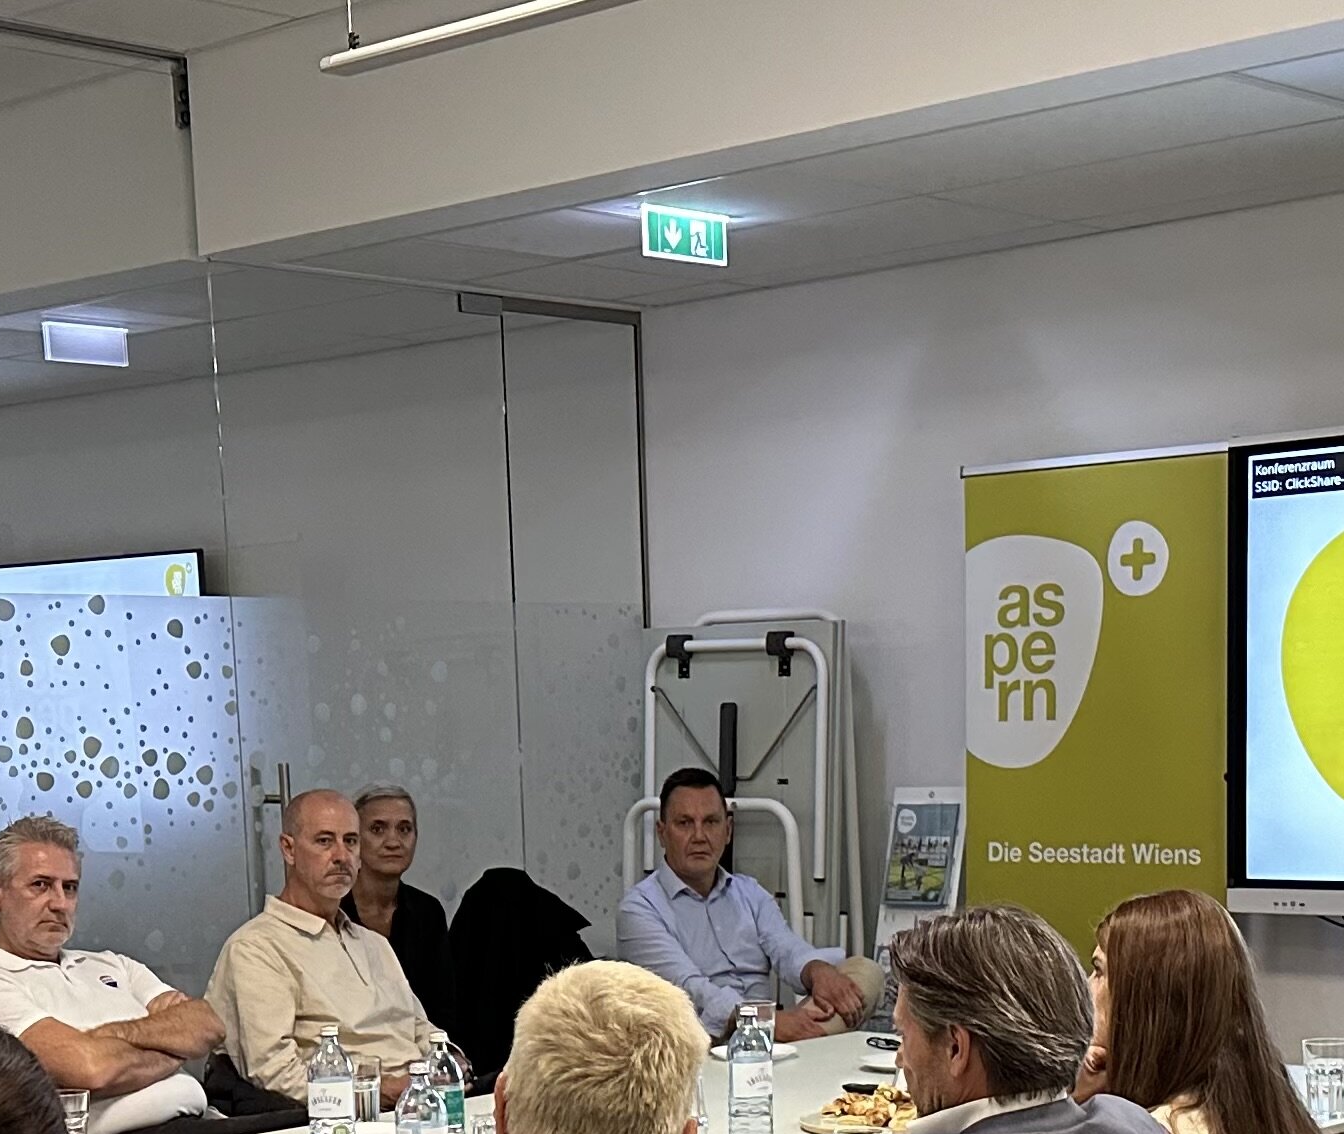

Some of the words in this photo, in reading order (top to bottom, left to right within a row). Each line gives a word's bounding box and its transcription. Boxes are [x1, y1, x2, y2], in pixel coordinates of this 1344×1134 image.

[1255, 458, 1335, 476] Konferenzraum
[1255, 481, 1283, 493] SSID:
[997, 582, 1065, 629] as
[984, 630, 1056, 690] pe
[998, 678, 1056, 722] rn
[987, 841, 1022, 863] Die
[1028, 841, 1126, 865] Seestadt
[1131, 843, 1202, 866] Wiens
